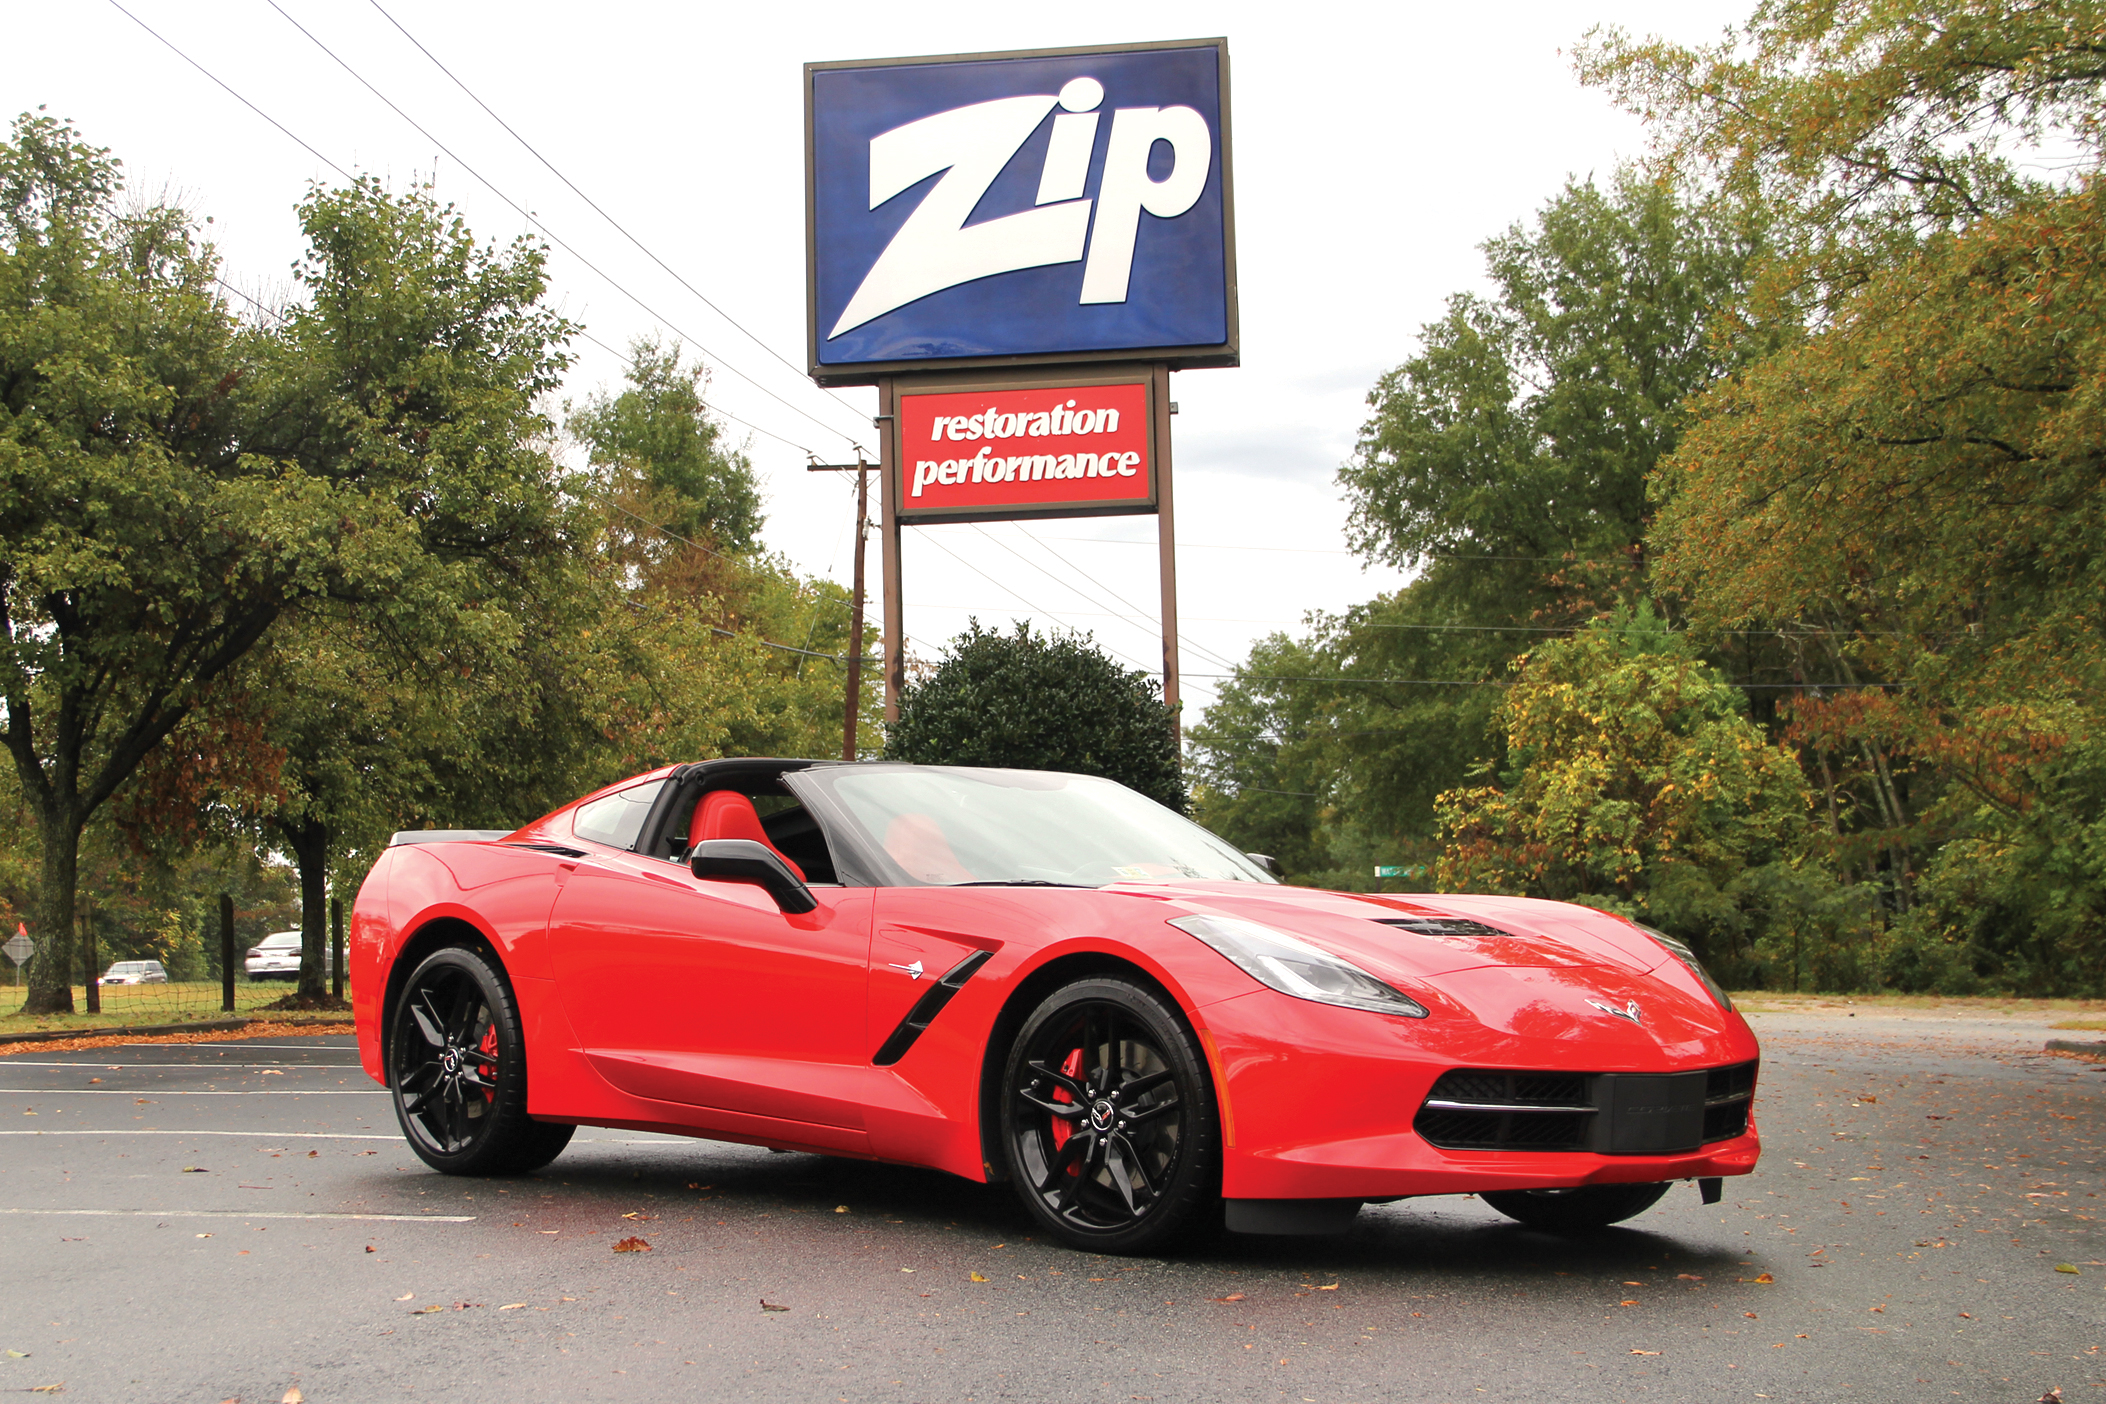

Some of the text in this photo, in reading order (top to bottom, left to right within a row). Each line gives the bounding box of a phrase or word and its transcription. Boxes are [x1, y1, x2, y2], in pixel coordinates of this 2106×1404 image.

[827, 76, 1212, 341] Zip
[931, 400, 1119, 441] restoration
[911, 446, 1141, 497] performance
